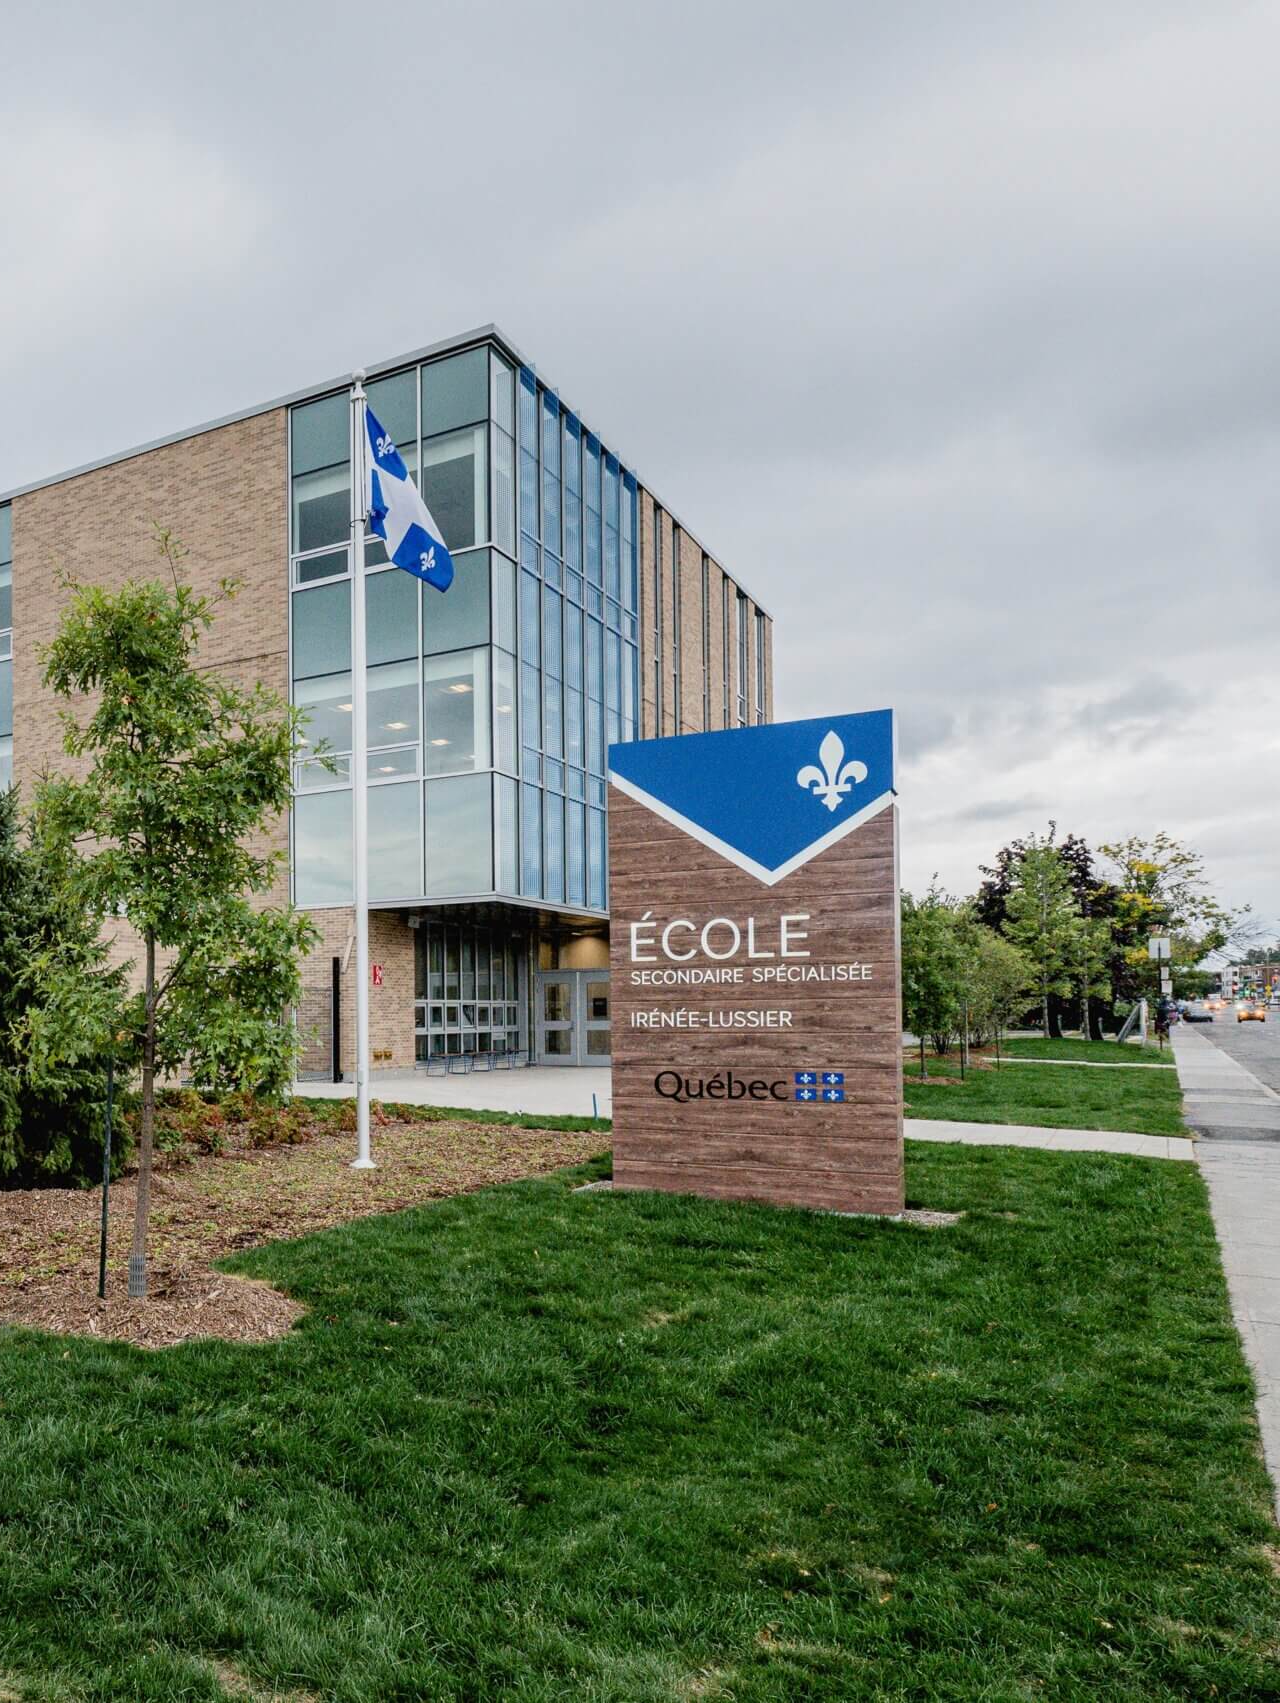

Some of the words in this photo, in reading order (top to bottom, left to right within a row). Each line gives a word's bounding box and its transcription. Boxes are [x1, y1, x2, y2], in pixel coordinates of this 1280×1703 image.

[630, 911, 811, 962] ÉCOLE
[631, 967, 744, 986] SECONDAIRE
[752, 961, 873, 983] SPÉCIALISÉE
[631, 1007, 793, 1028] IRÉNÉE-LUSSIER
[654, 1070, 789, 1103] Québec
